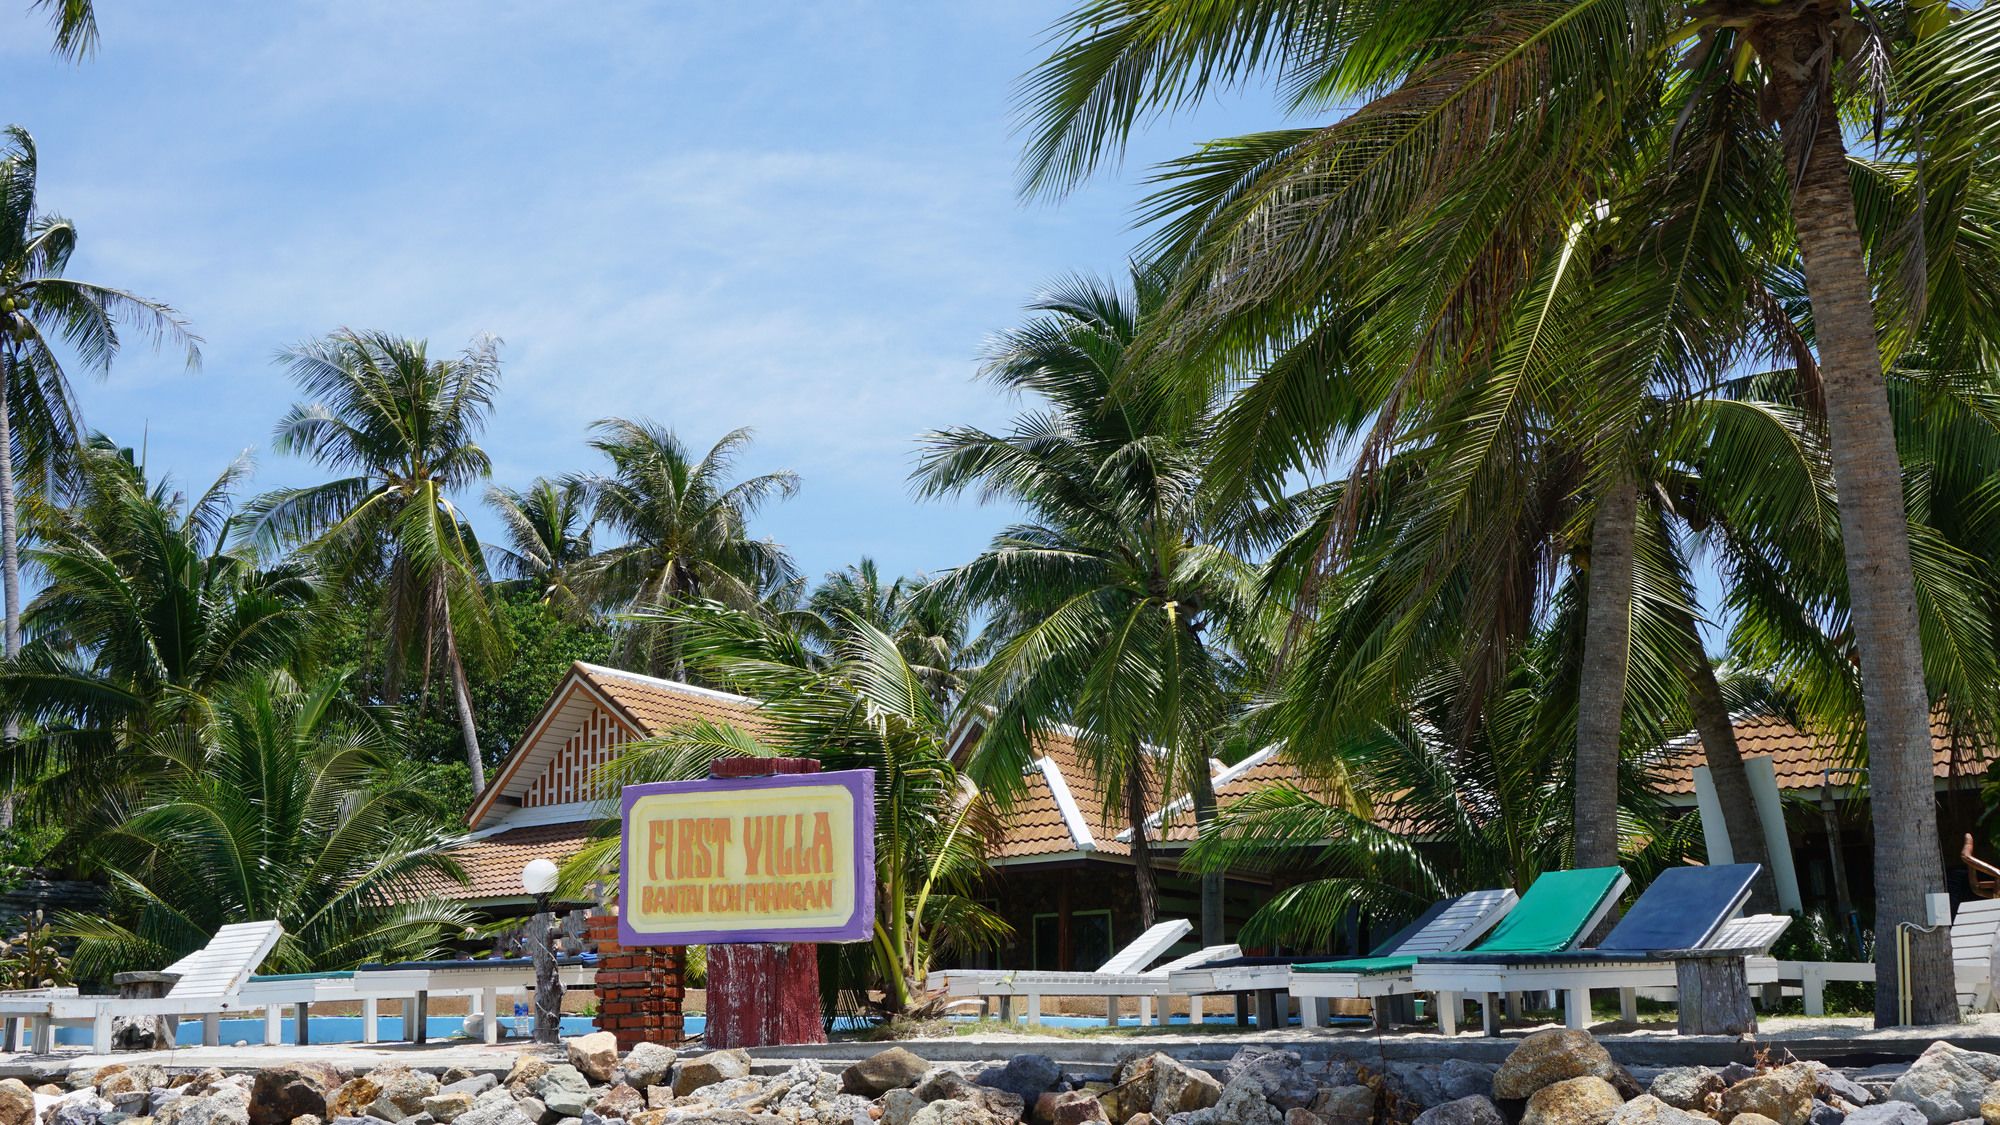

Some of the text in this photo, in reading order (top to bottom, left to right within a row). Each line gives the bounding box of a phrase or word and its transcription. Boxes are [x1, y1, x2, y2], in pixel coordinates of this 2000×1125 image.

[648, 812, 834, 880] FIRST VILLA
[642, 880, 833, 914] BANTAI KOH PHANGAN
